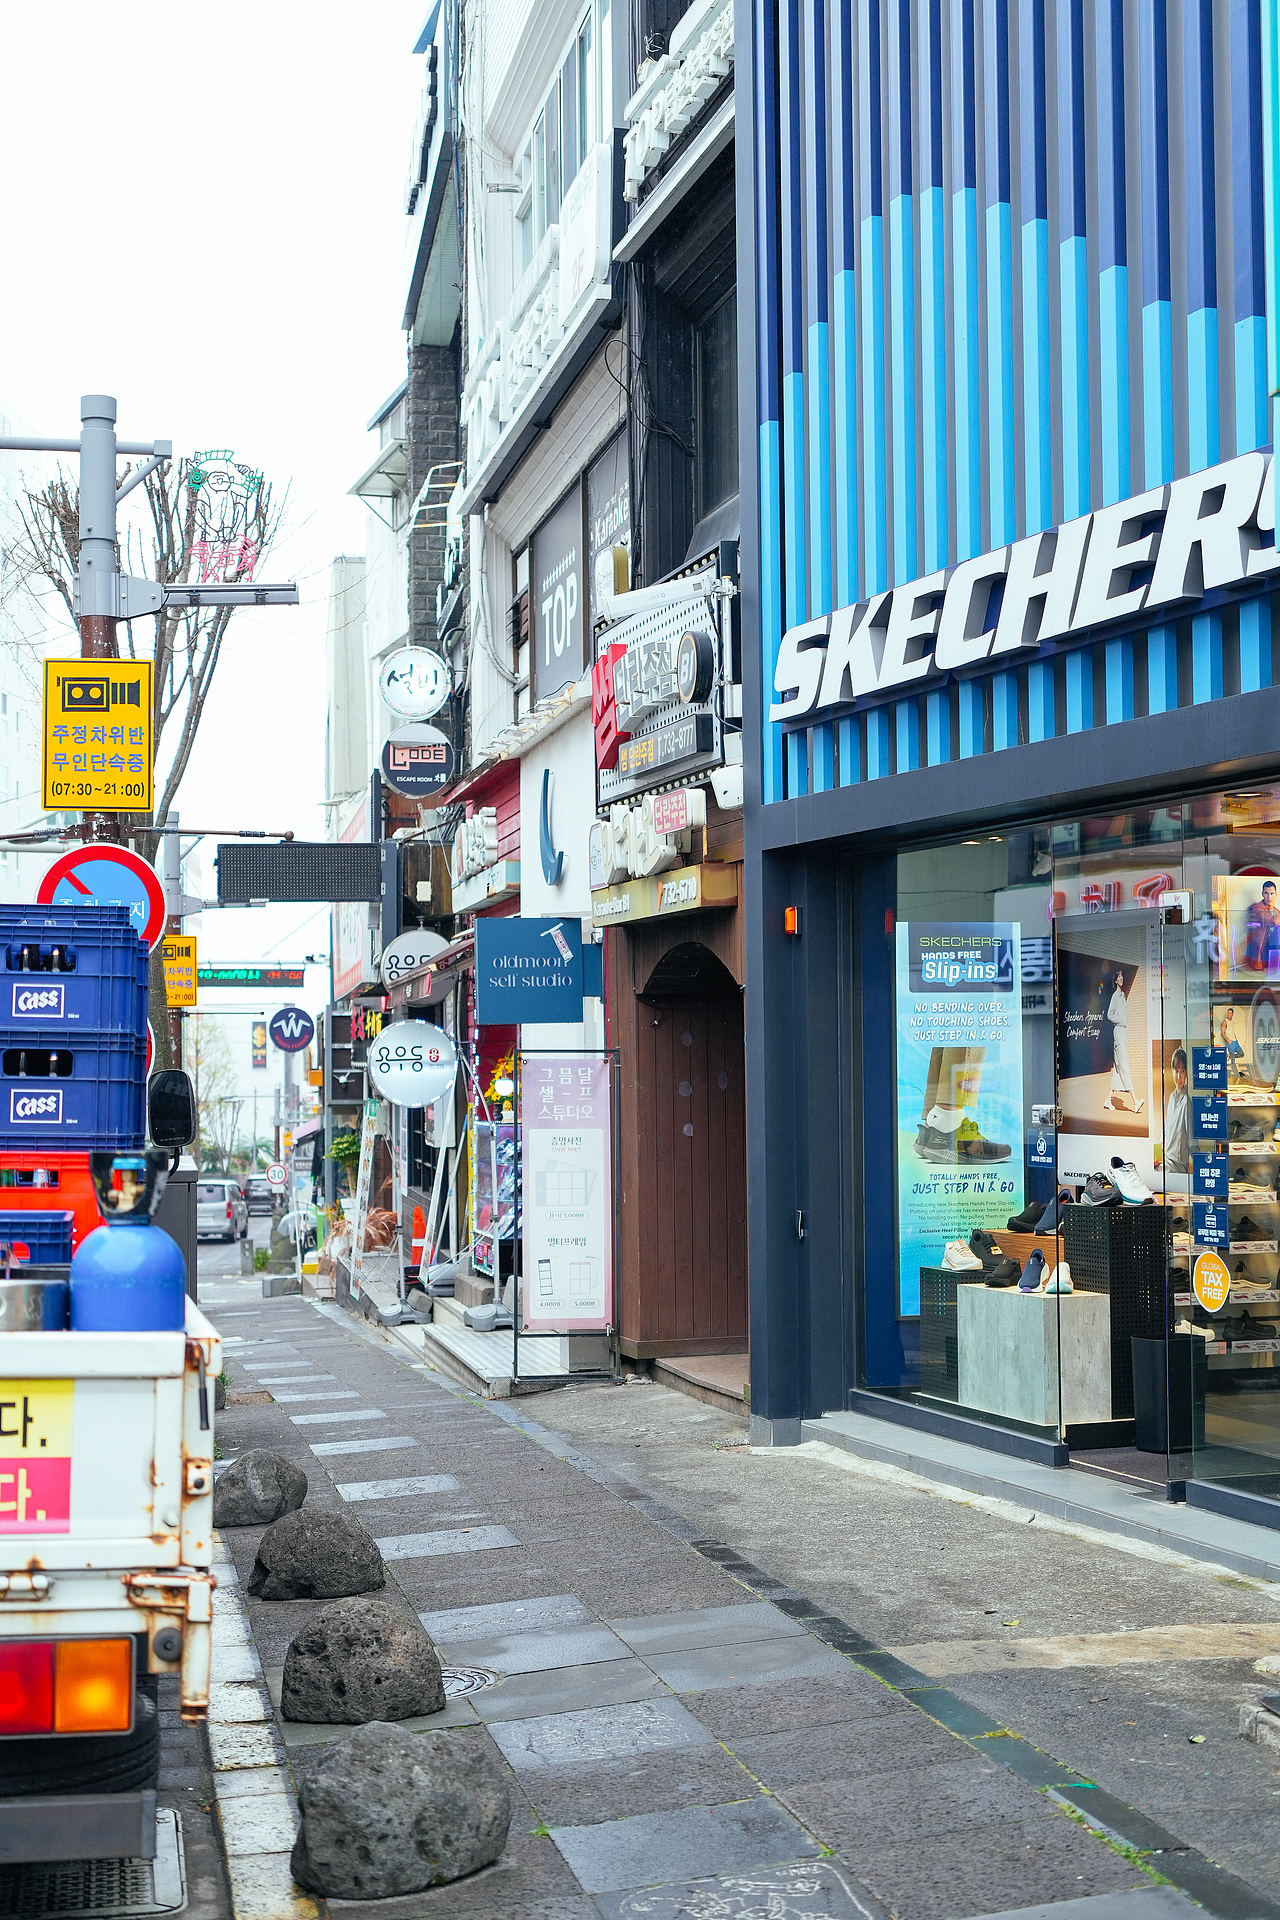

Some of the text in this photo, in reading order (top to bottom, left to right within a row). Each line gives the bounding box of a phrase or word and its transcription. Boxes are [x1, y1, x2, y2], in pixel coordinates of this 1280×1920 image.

[595, 496, 629, 550] Karaoke
[541, 572, 578, 666] TOP
[387, 663, 438, 696] 설빙
[613, 641, 677, 732] 단란주점
[681, 650, 695, 685] B1
[52, 725, 144, 745] 주정차위반
[629, 738, 654, 768] 단란주점
[52, 752, 144, 772] 무인단속중
[655, 792, 686, 832] 단란주점
[919, 936, 1002, 947] SKECHERS
[921, 950, 982, 960] HANDS FREE
[925, 960, 996, 983] Slip-ins
[163, 979, 193, 989] 단속중
[489, 972, 572, 987] self studio
[915, 1002, 1007, 1013] NO BENDING OVER.
[910, 1016, 1011, 1027] NO TOUCHING SHOES.
[914, 1030, 1006, 1041] JUST STEP IN & GO.
[537, 1104, 594, 1121] 스튜디오
[551, 1136, 582, 1146] 증명사진
[270, 1170, 284, 1180] 30
[929, 1172, 1001, 1181] TOTALLY HANDS FREE,
[912, 1181, 1014, 1195] JUST STEP IN & GO
[547, 1237, 587, 1247] 멀티프레임
[1201, 1261, 1223, 1272] GLOBAL
[1200, 1270, 1224, 1288] TAX
[1202, 1286, 1223, 1300] FREE
